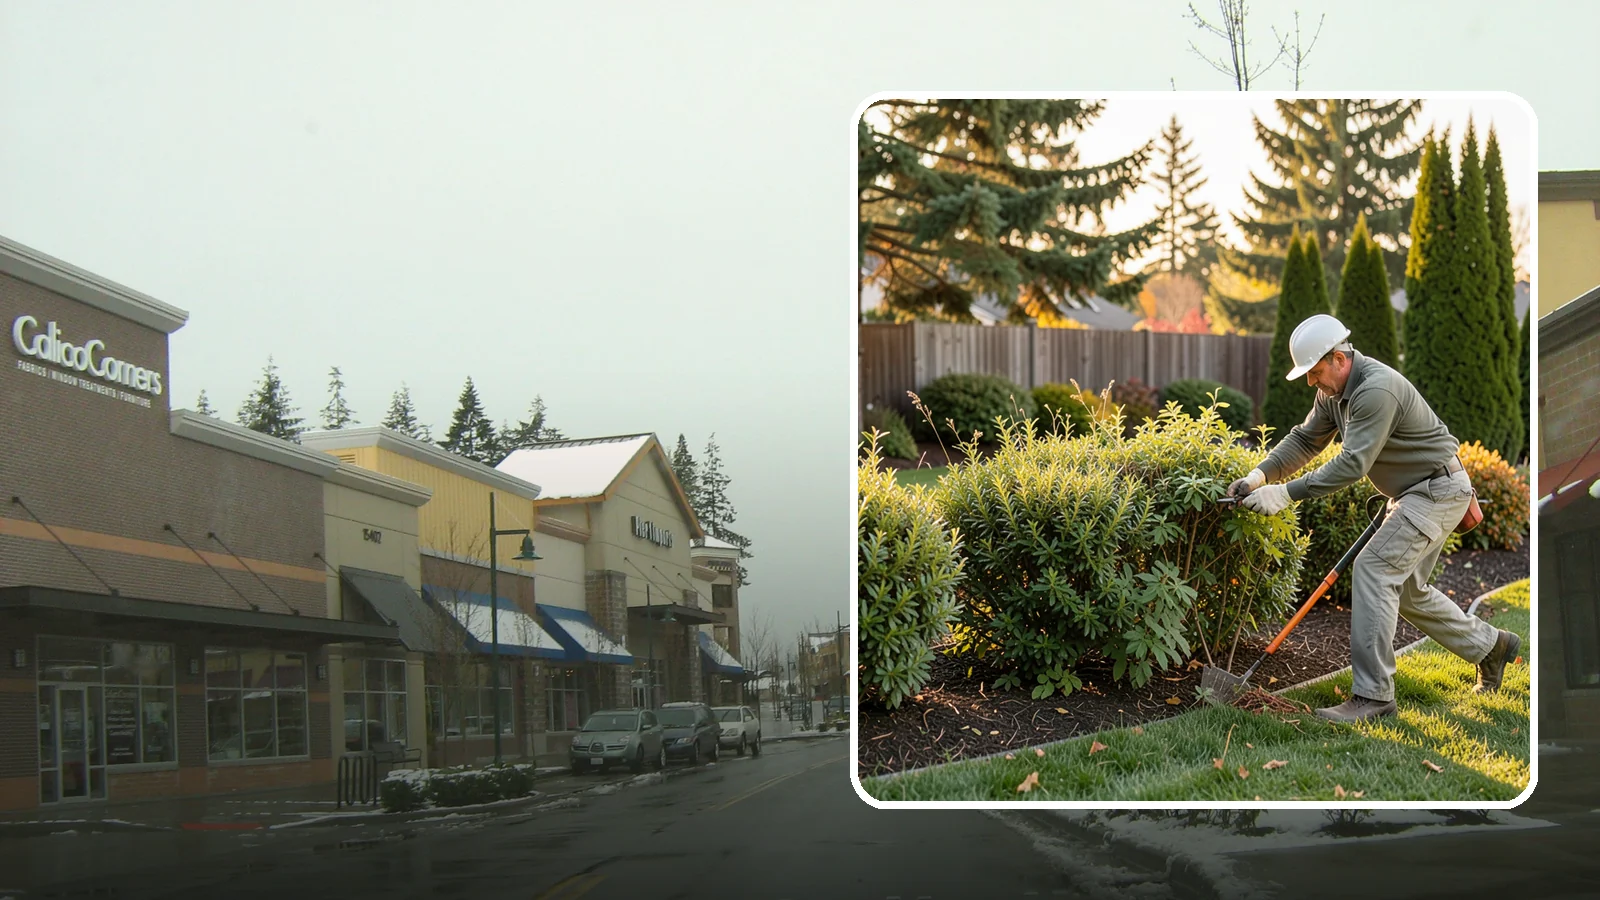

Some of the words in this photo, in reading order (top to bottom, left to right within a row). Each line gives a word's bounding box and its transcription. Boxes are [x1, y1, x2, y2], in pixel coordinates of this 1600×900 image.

[17, 359, 47, 377] FABRICS
[51, 370, 78, 386] WINDOW
[79, 378, 116, 398] TREATMENTS
[120, 391, 151, 408] FURNITURE
